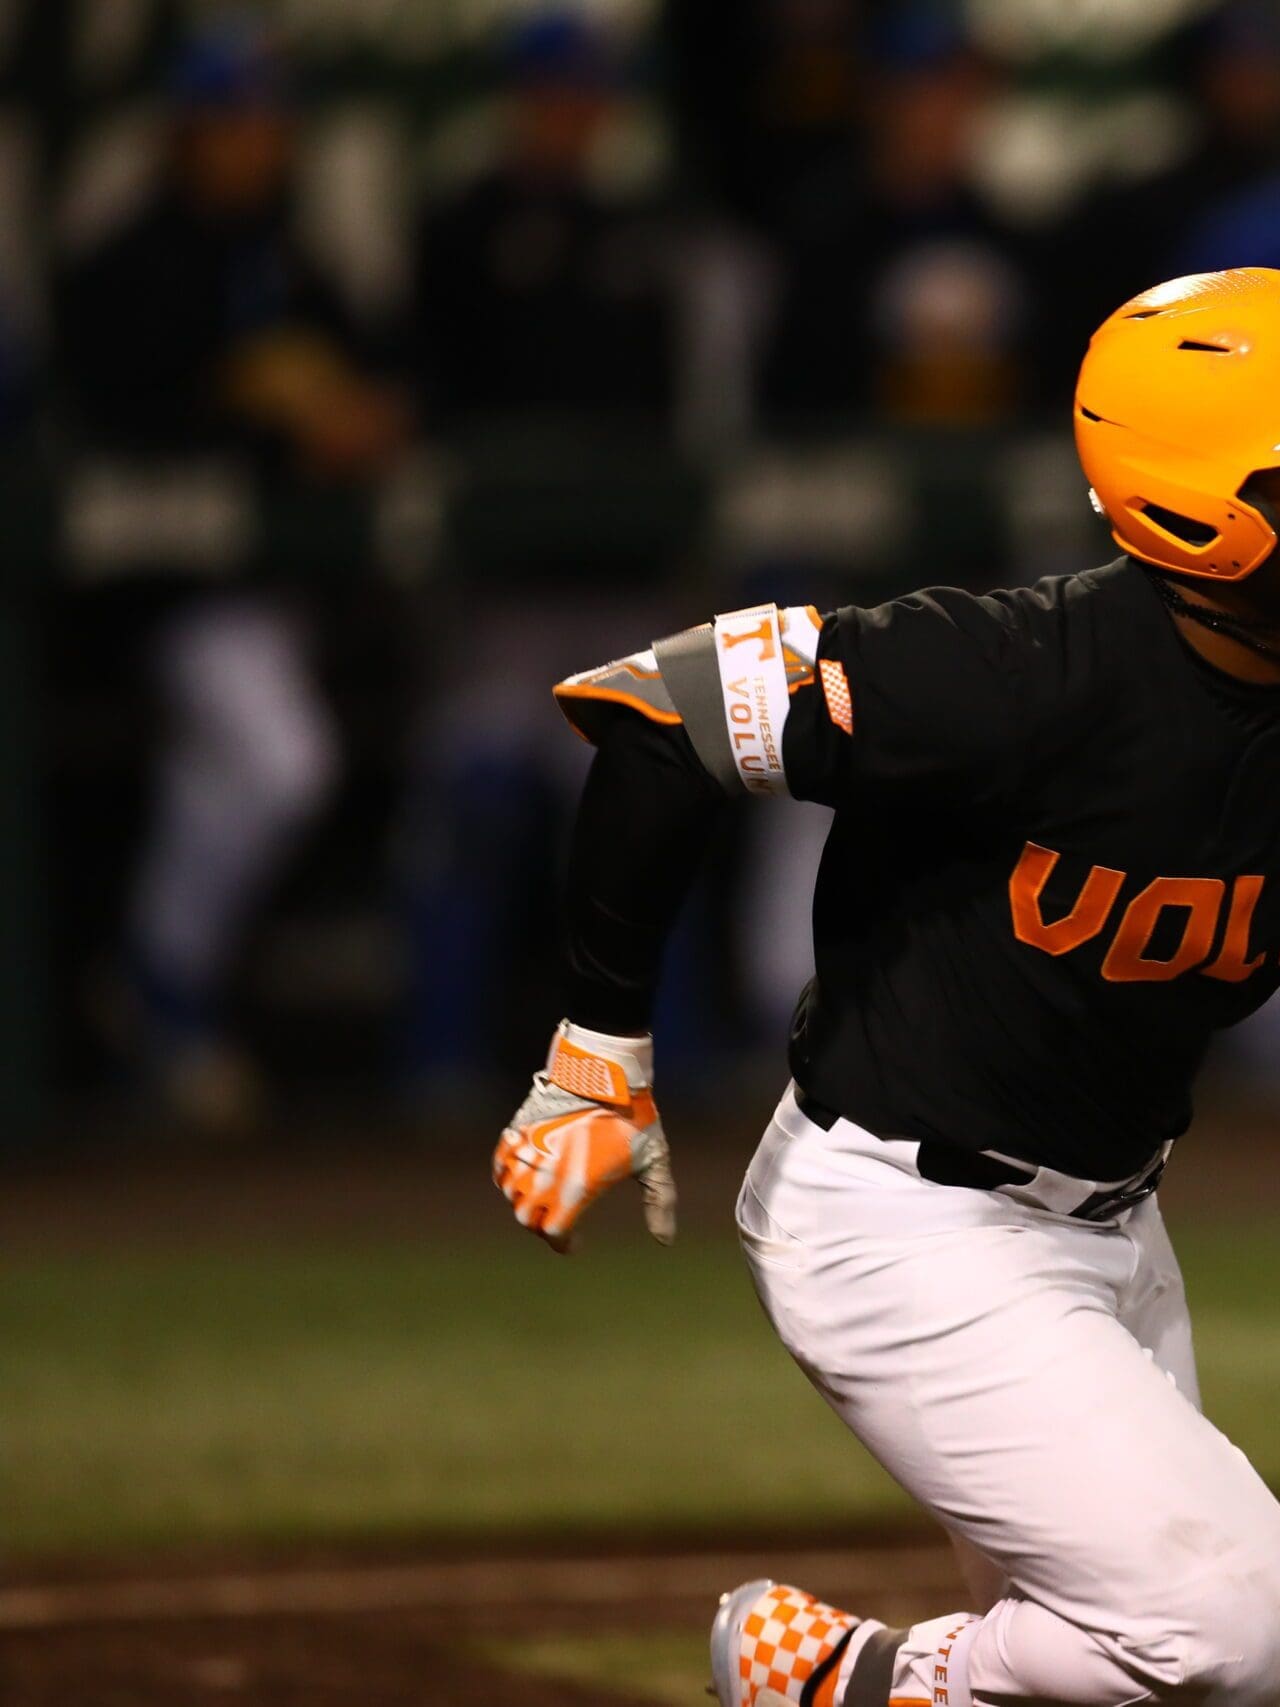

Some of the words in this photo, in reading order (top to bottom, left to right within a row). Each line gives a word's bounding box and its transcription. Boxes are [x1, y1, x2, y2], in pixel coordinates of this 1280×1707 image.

[722, 618, 776, 661] T
[754, 676, 780, 770] TENNESSEE
[934, 1618, 975, 1706] NTEE
